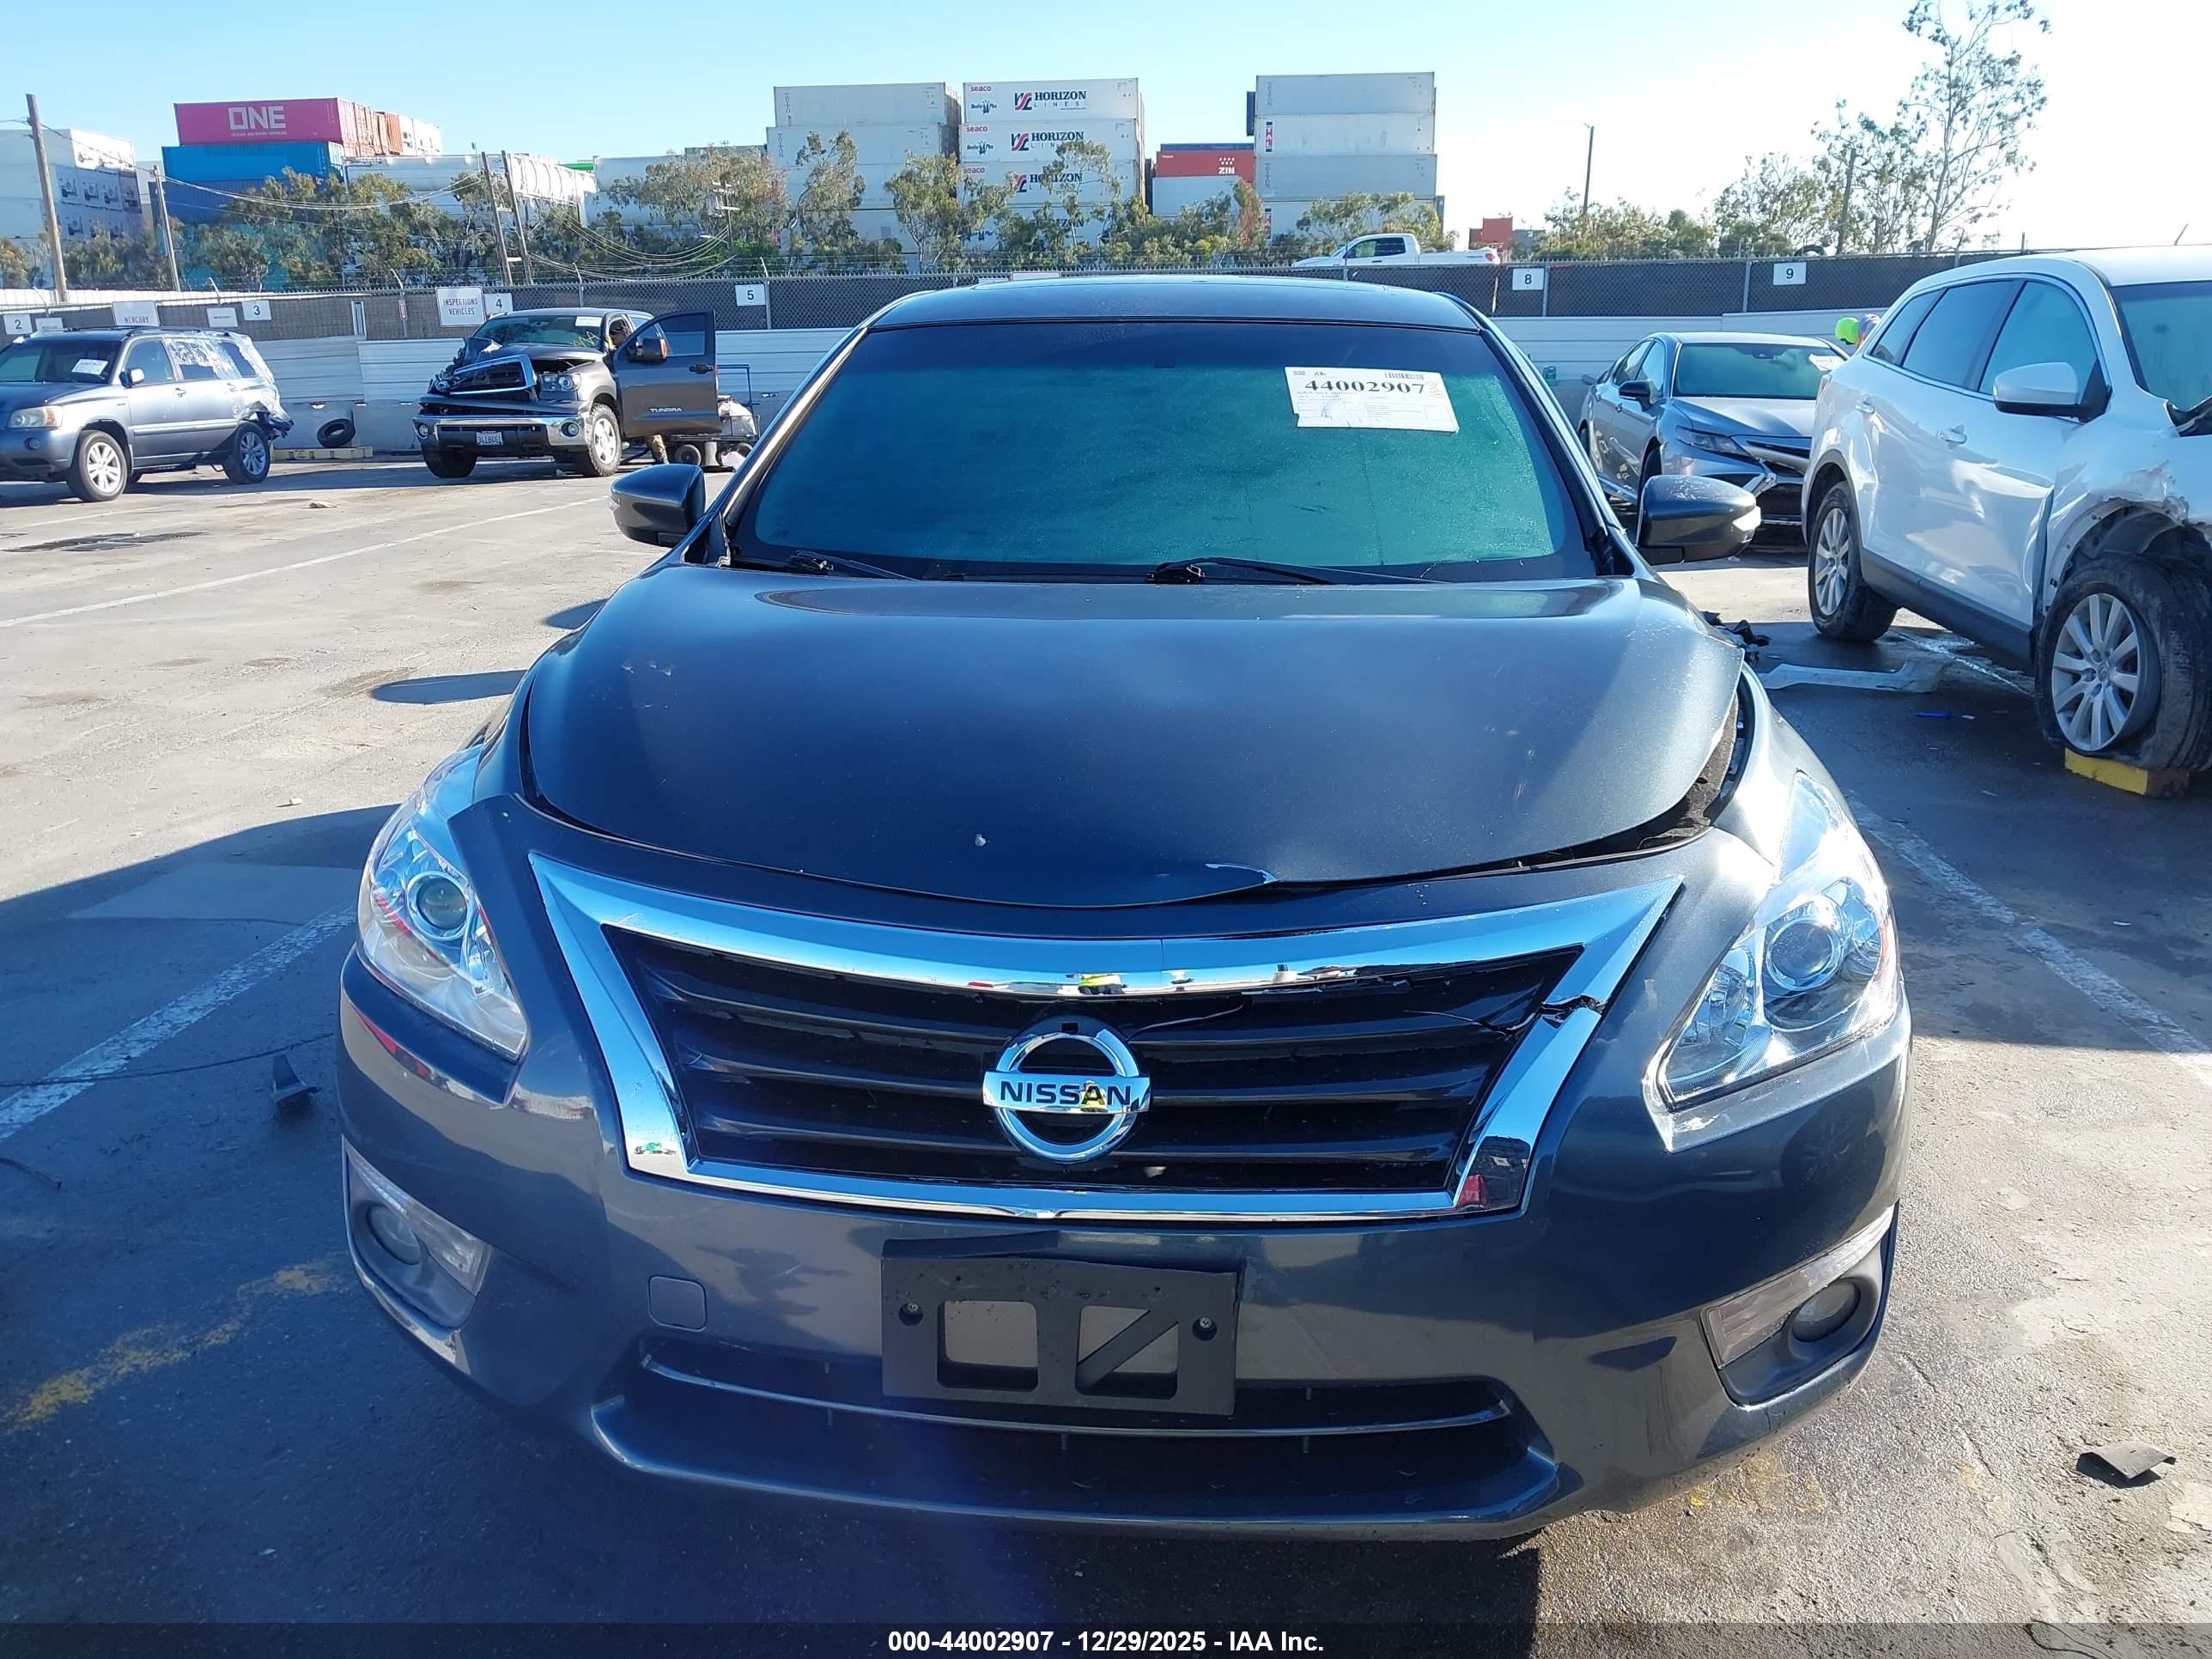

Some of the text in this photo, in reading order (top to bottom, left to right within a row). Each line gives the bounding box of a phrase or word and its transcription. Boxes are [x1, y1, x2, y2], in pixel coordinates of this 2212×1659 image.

[1035, 90, 1086, 100] HORIZON
[228, 106, 286, 131] ONE
[1030, 131, 1085, 142] HORIZON
[1524, 273, 1532, 285] 8
[1786, 268, 1794, 279] 9
[747, 289, 755, 301] 5
[443, 297, 478, 307] INSPECTIONS
[495, 298, 503, 309] 4
[253, 305, 261, 316] 3
[448, 307, 475, 316] VEHICLES
[15, 319, 22, 330] 2
[125, 315, 149, 324] MERCURY
[1304, 380, 1425, 394] 44002907
[1000, 1080, 1132, 1107] NISSAN
